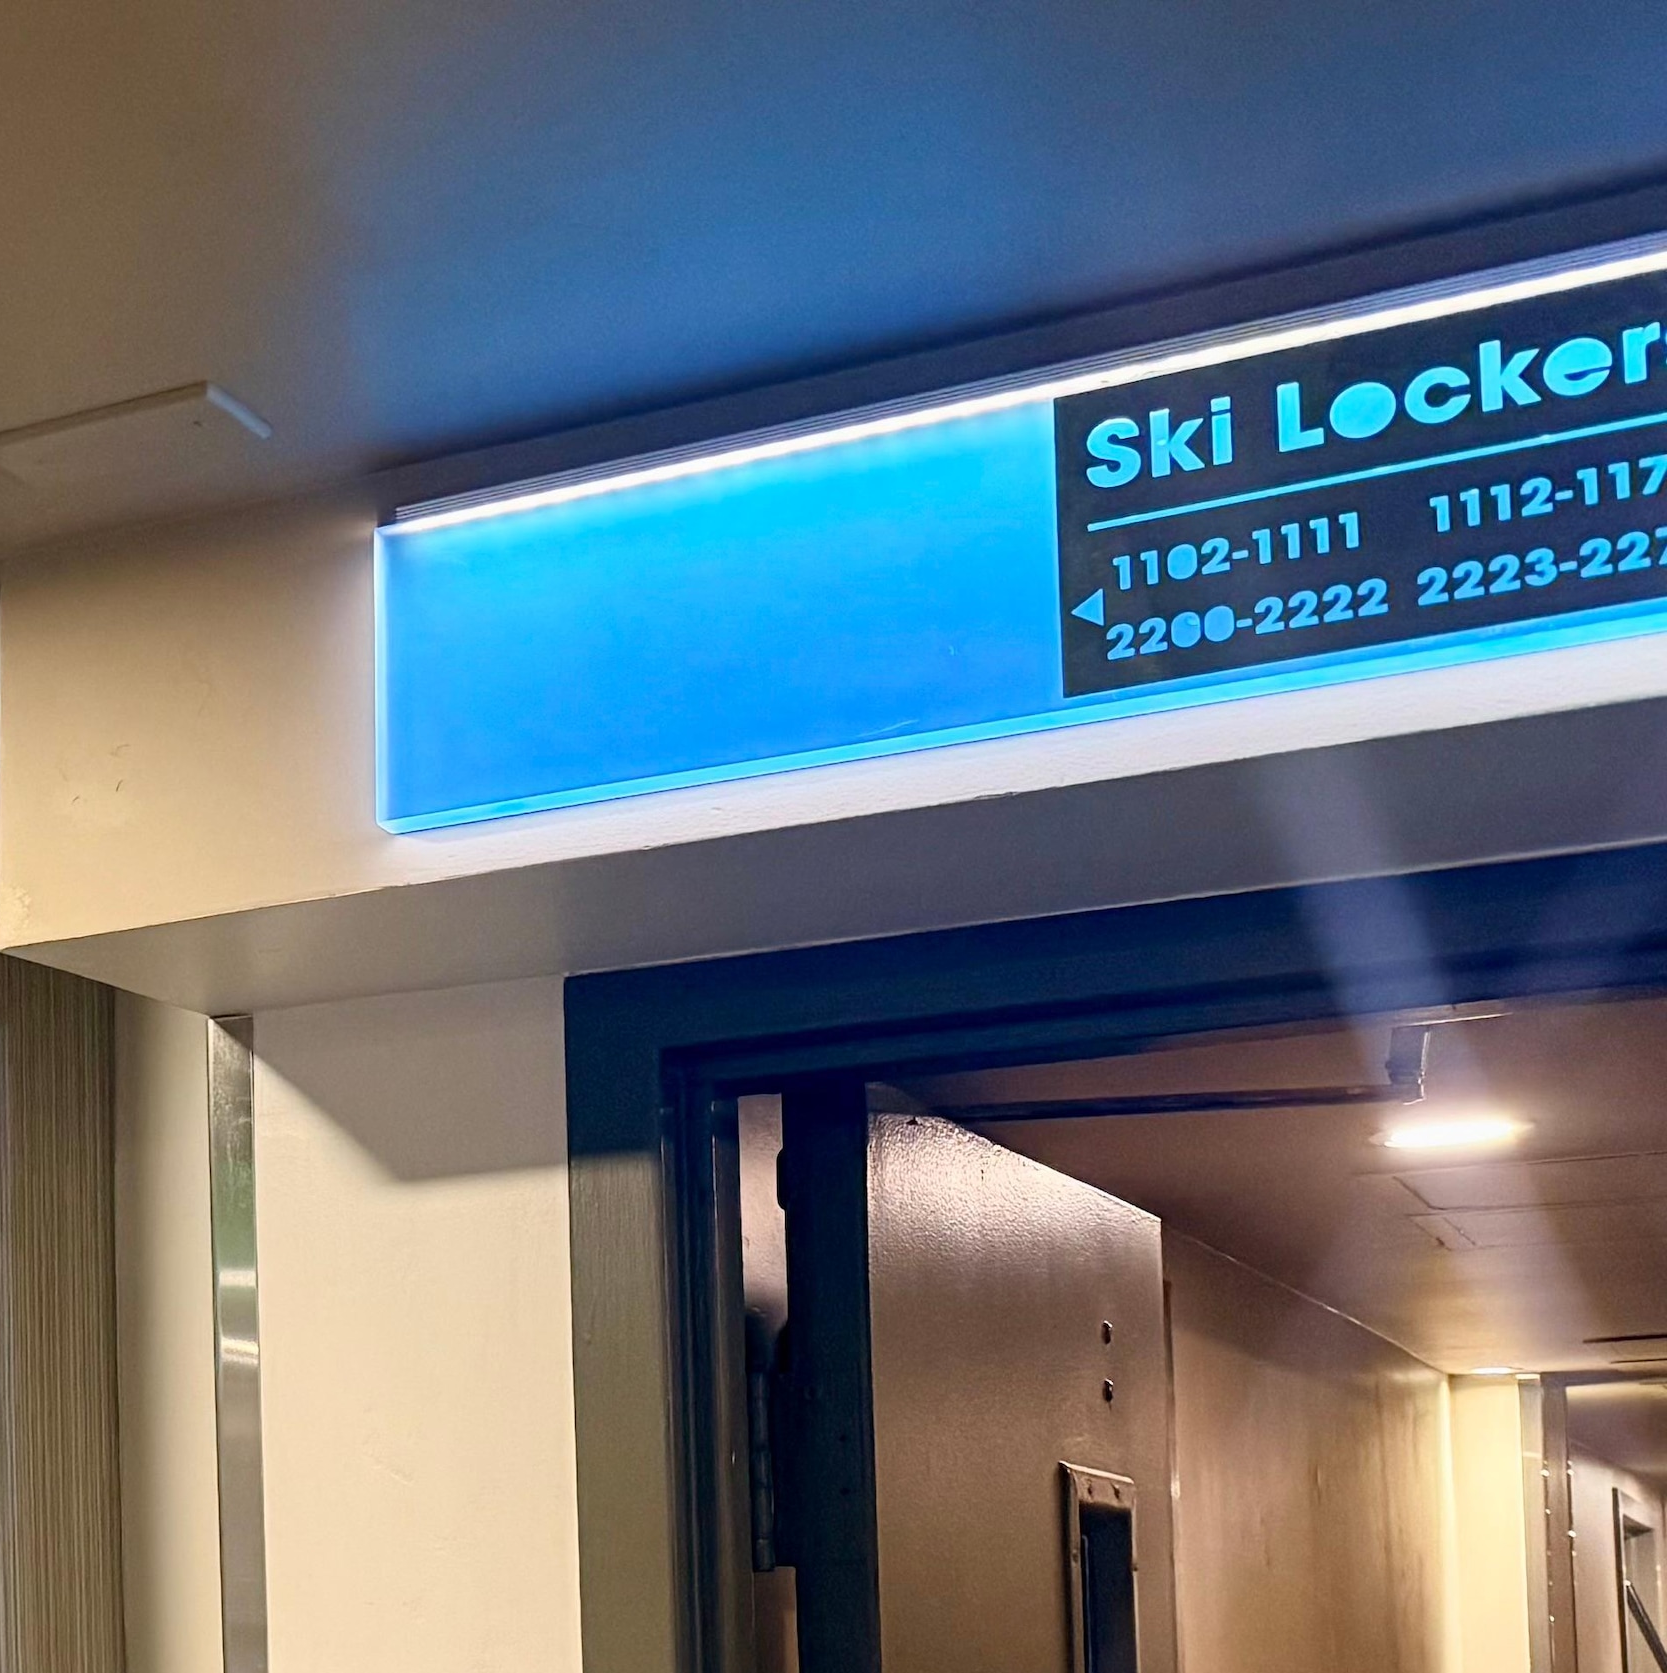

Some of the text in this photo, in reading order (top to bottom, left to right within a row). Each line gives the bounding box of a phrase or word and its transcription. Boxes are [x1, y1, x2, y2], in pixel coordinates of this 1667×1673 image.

[1086, 320, 1667, 488] Ski Locker
[1113, 512, 1360, 590] 1102-1111
[1106, 578, 1389, 660] 2200-2222
